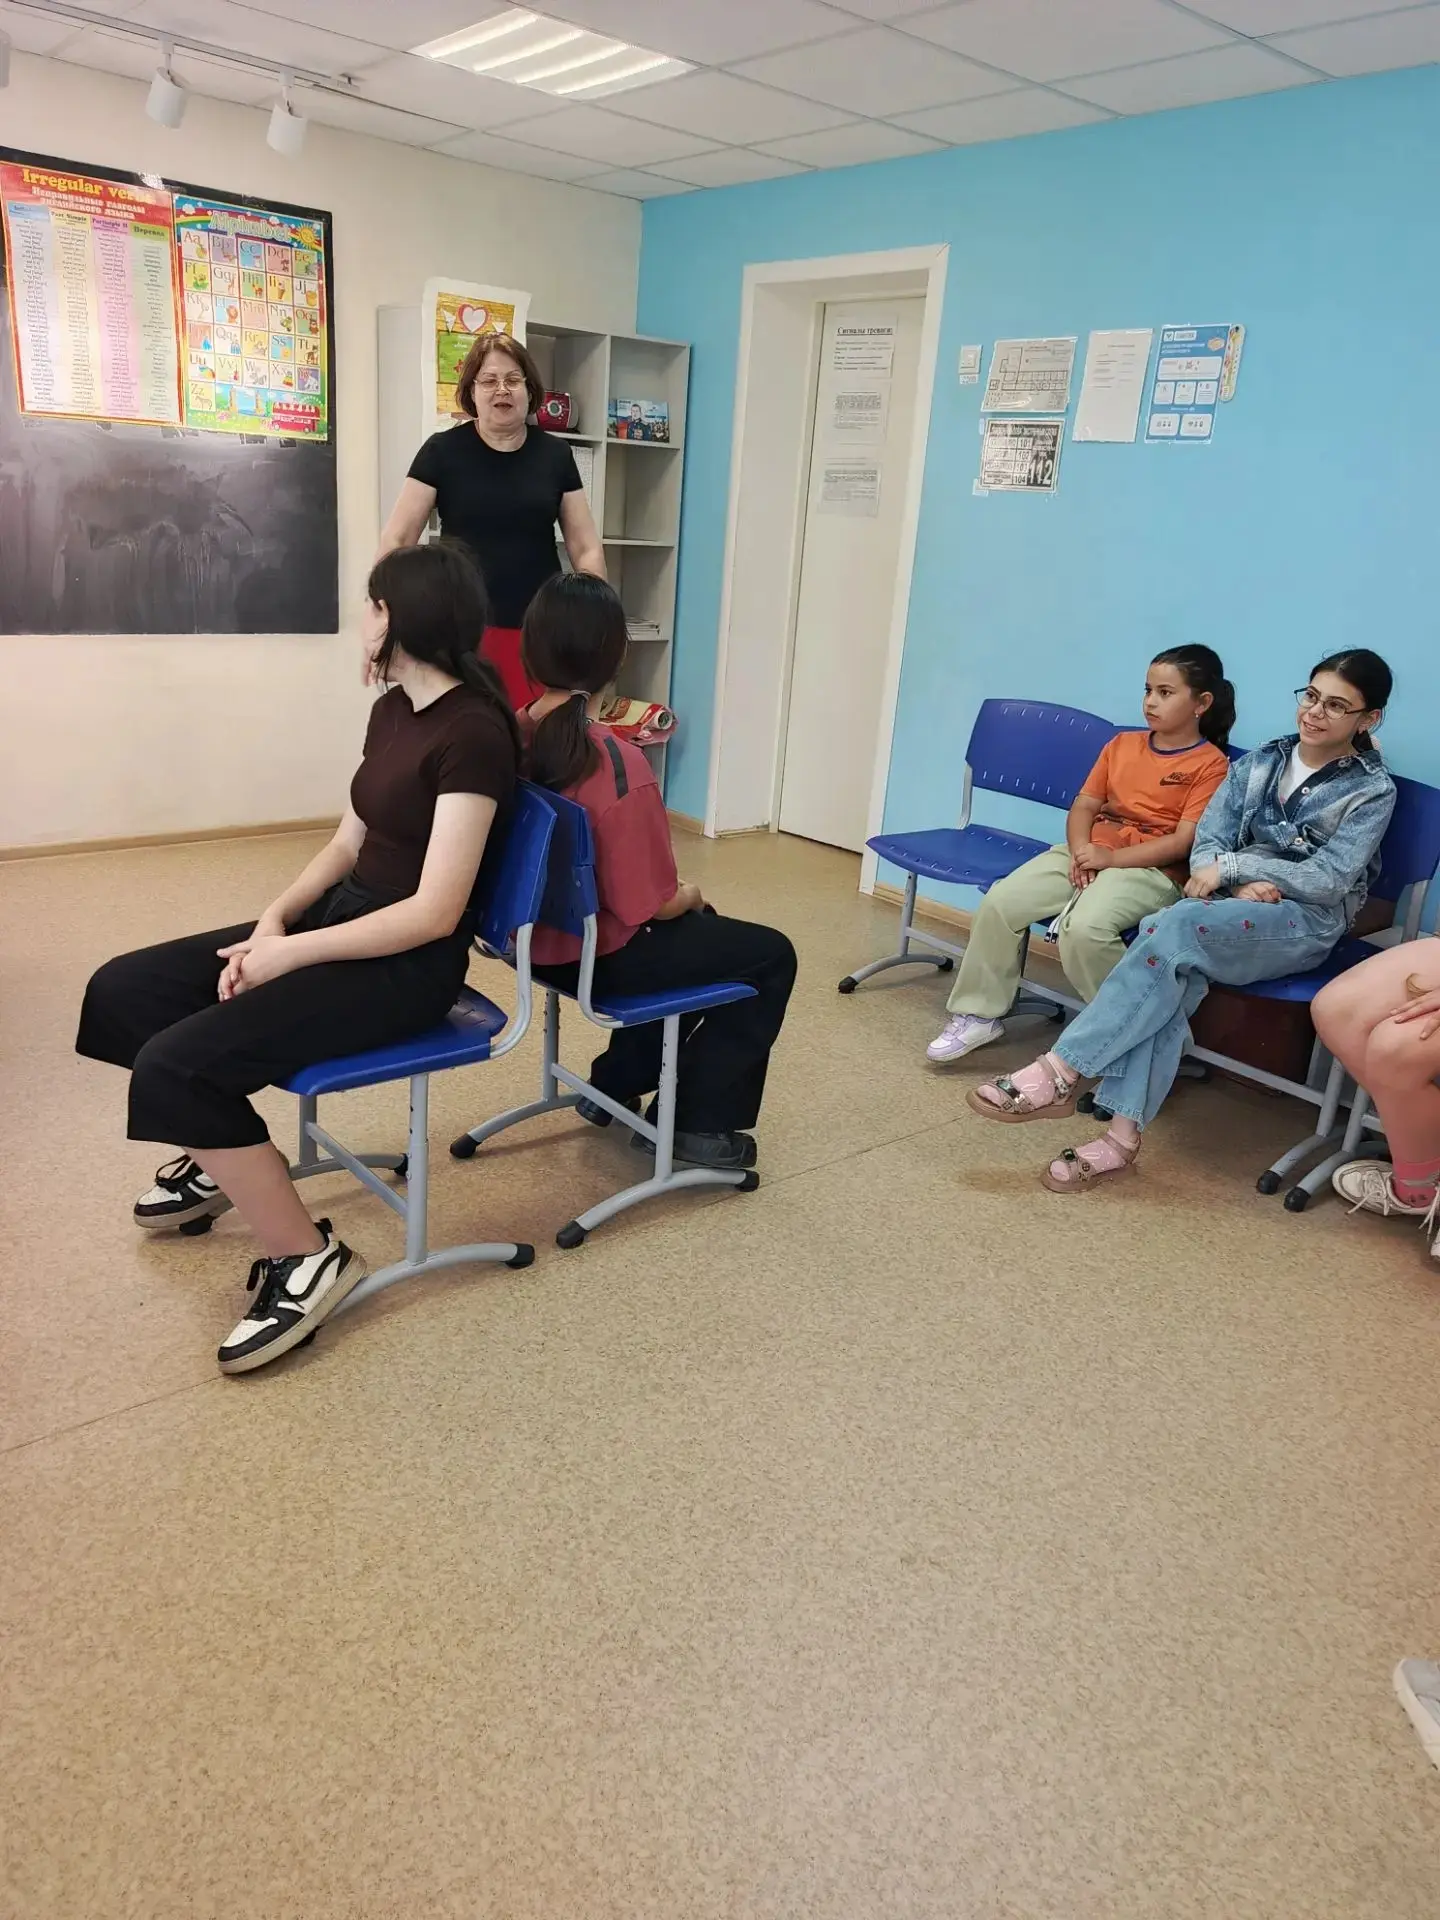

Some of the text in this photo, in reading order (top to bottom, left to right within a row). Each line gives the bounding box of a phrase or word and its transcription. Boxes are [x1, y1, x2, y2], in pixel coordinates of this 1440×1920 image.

[23, 168, 103, 195] Irregular
[31, 186, 146, 214] Неправильные глаголы
[208, 210, 290, 240] Alphabet
[1014, 475, 1027, 484] 104
[1029, 459, 1053, 485] 112
